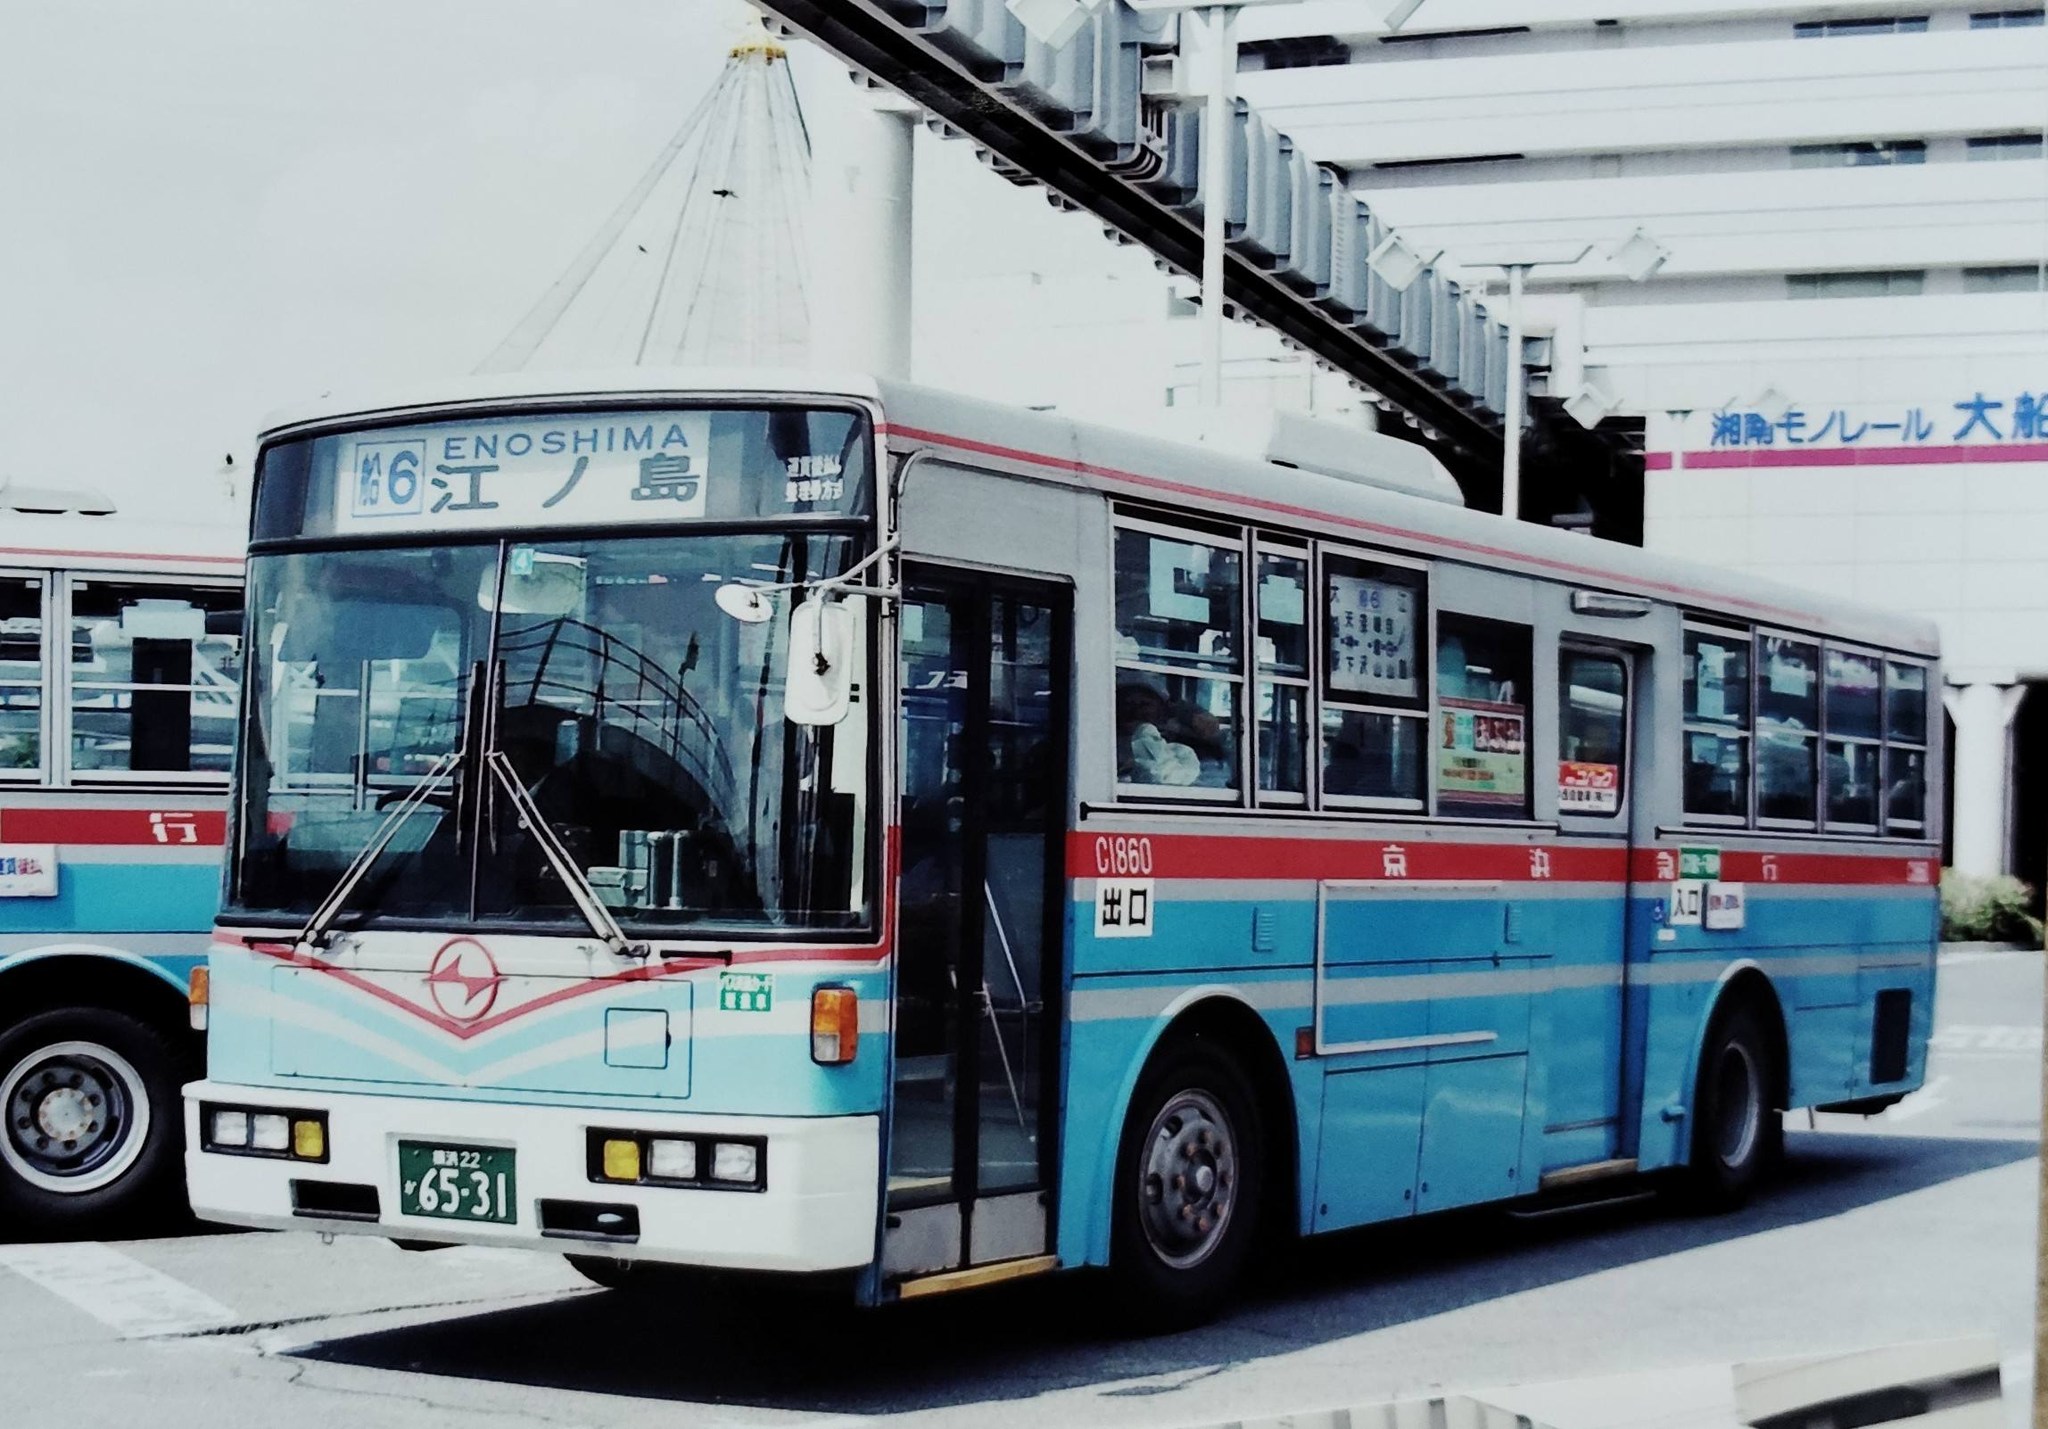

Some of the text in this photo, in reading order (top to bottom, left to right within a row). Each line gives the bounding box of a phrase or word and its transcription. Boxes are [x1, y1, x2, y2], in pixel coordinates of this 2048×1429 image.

[443, 424, 690, 461] ENOSHIMA
[1711, 408, 1933, 447] 湘南モノレール
[430, 452, 702, 514] 江ノ島
[149, 812, 198, 843] 行
[1095, 836, 1153, 875] C1860
[1102, 887, 1148, 926] 出口
[1673, 888, 1699, 917] 入口
